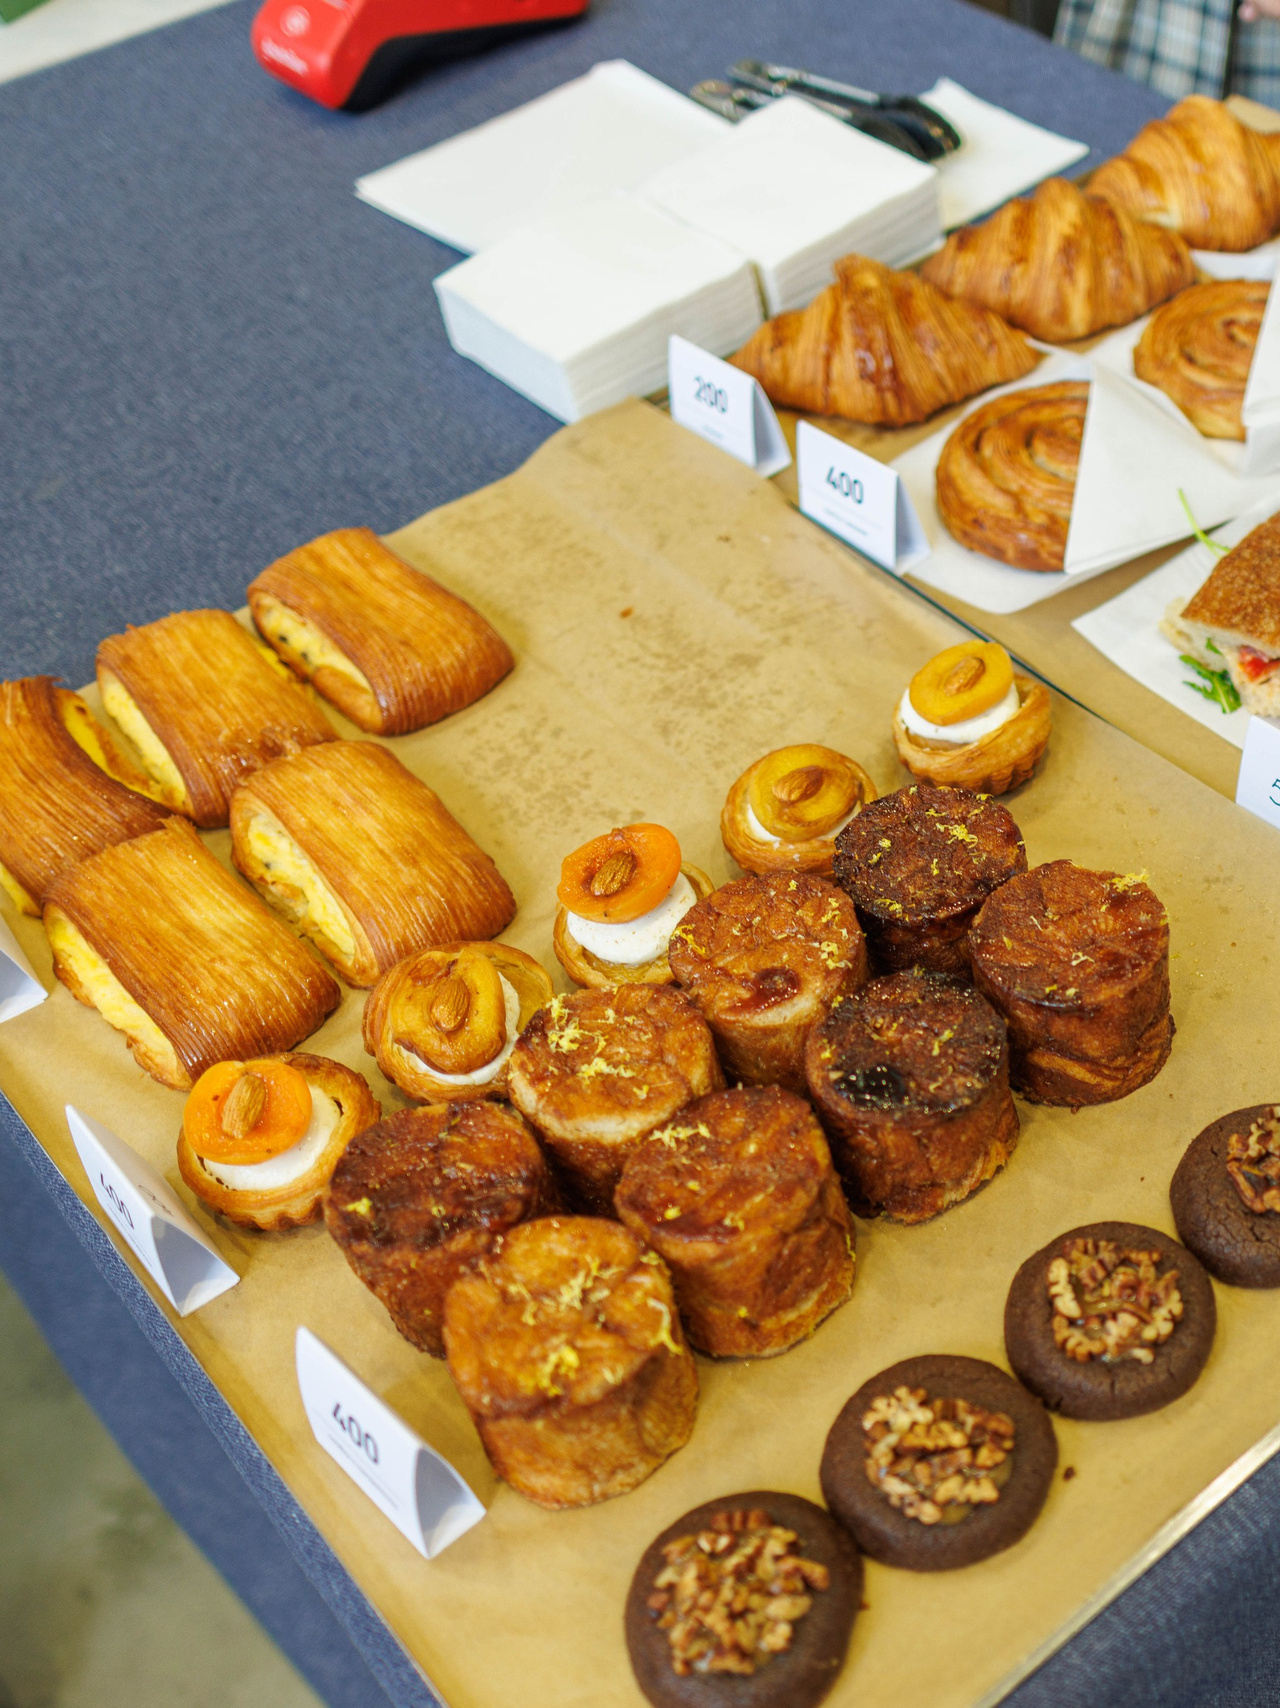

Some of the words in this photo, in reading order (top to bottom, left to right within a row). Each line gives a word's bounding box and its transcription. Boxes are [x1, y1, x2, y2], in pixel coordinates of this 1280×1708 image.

[695, 376, 728, 414] 200
[826, 466, 864, 504] 400
[332, 1403, 379, 1465] 400
